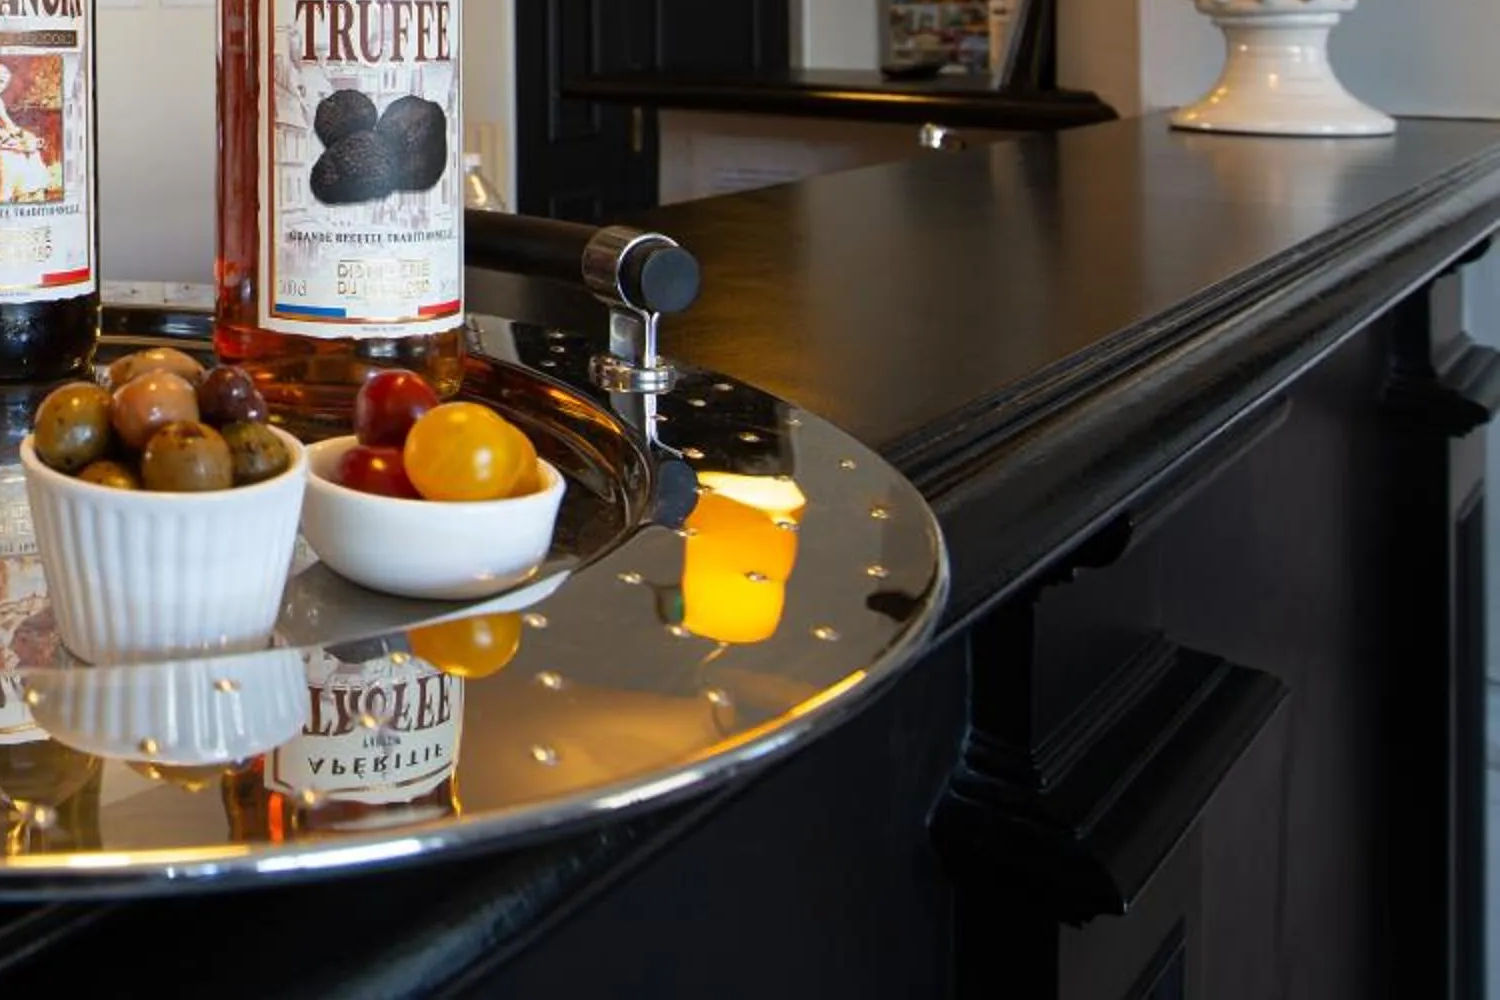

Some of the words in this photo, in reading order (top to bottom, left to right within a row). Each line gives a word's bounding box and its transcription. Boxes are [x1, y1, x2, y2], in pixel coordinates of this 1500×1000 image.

[295, 0, 451, 64] TRUFFE
[289, 231, 333, 243] GRANDE
[335, 232, 382, 245] RECETTE
[337, 281, 357, 296] DU
